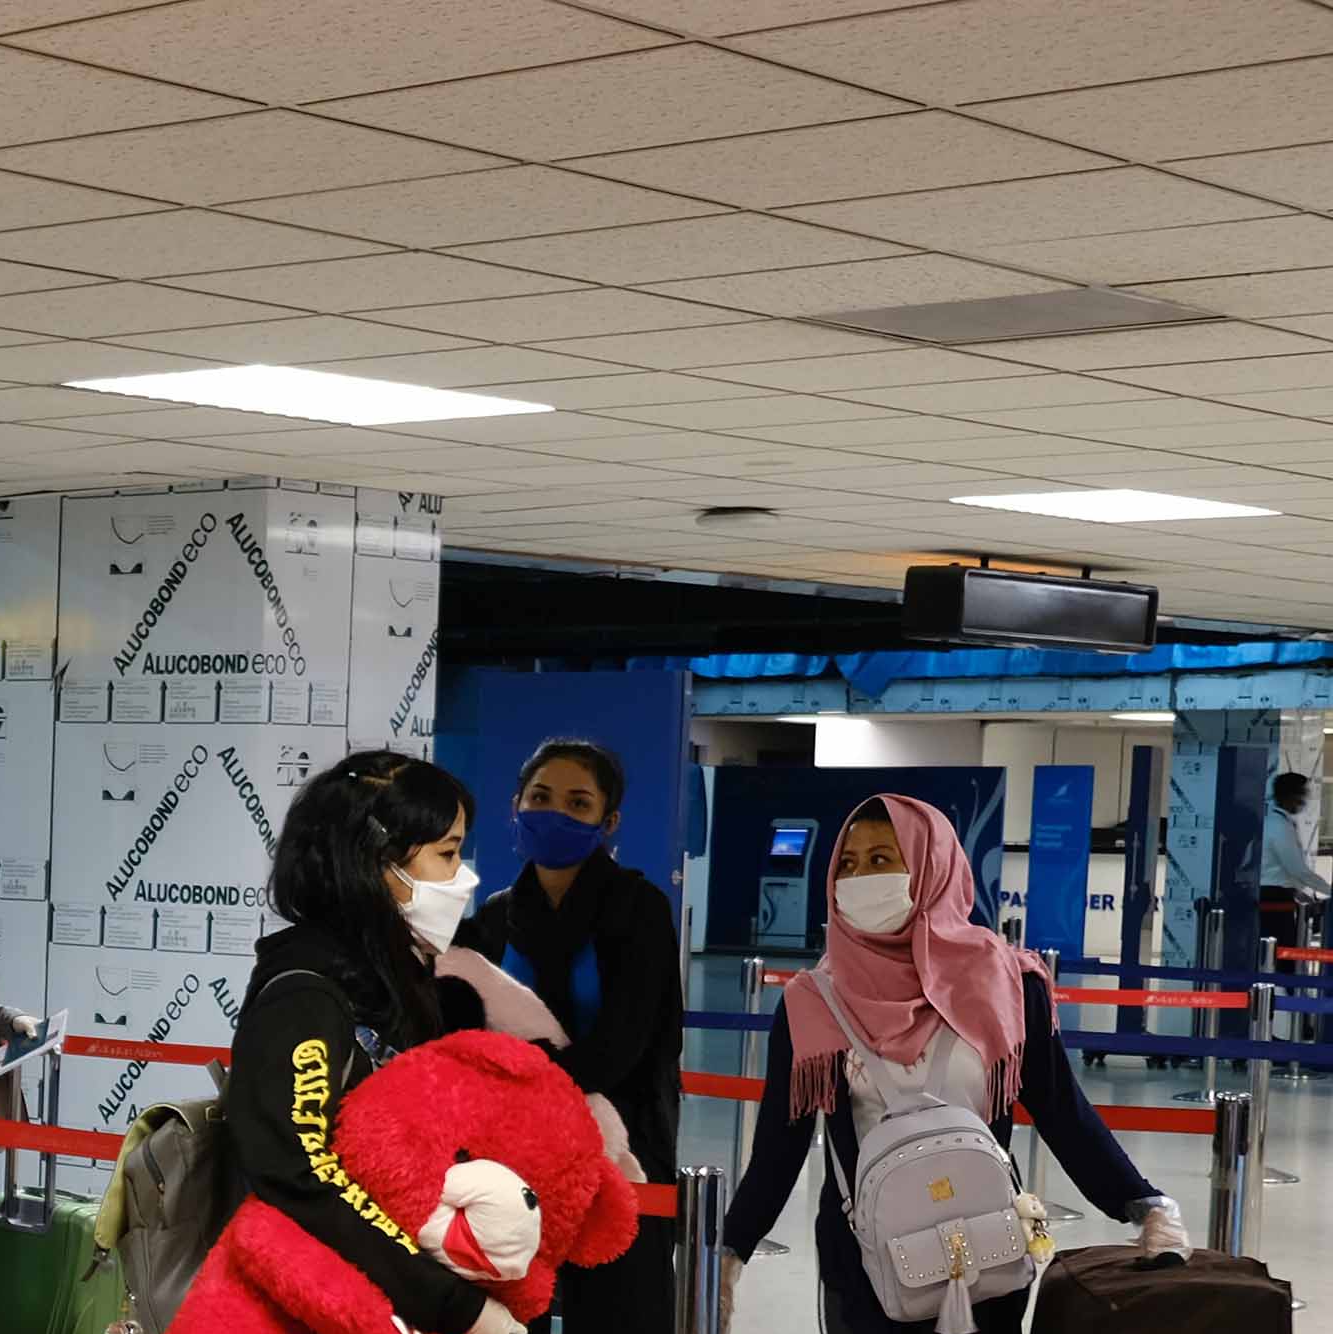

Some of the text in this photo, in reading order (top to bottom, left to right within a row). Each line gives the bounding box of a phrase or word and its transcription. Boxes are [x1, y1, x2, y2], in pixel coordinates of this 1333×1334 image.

[112, 559, 188, 677] ALUCOBOND
[183, 512, 217, 563] eco
[226, 512, 306, 677] ALUCOBOND eco
[142, 652, 287, 675] ALUCOBOND eco
[104, 790, 179, 901] ALUCOBOND
[174, 744, 208, 792] eco
[134, 880, 240, 905] ALUCOBOND
[166, 974, 200, 1020] eco
